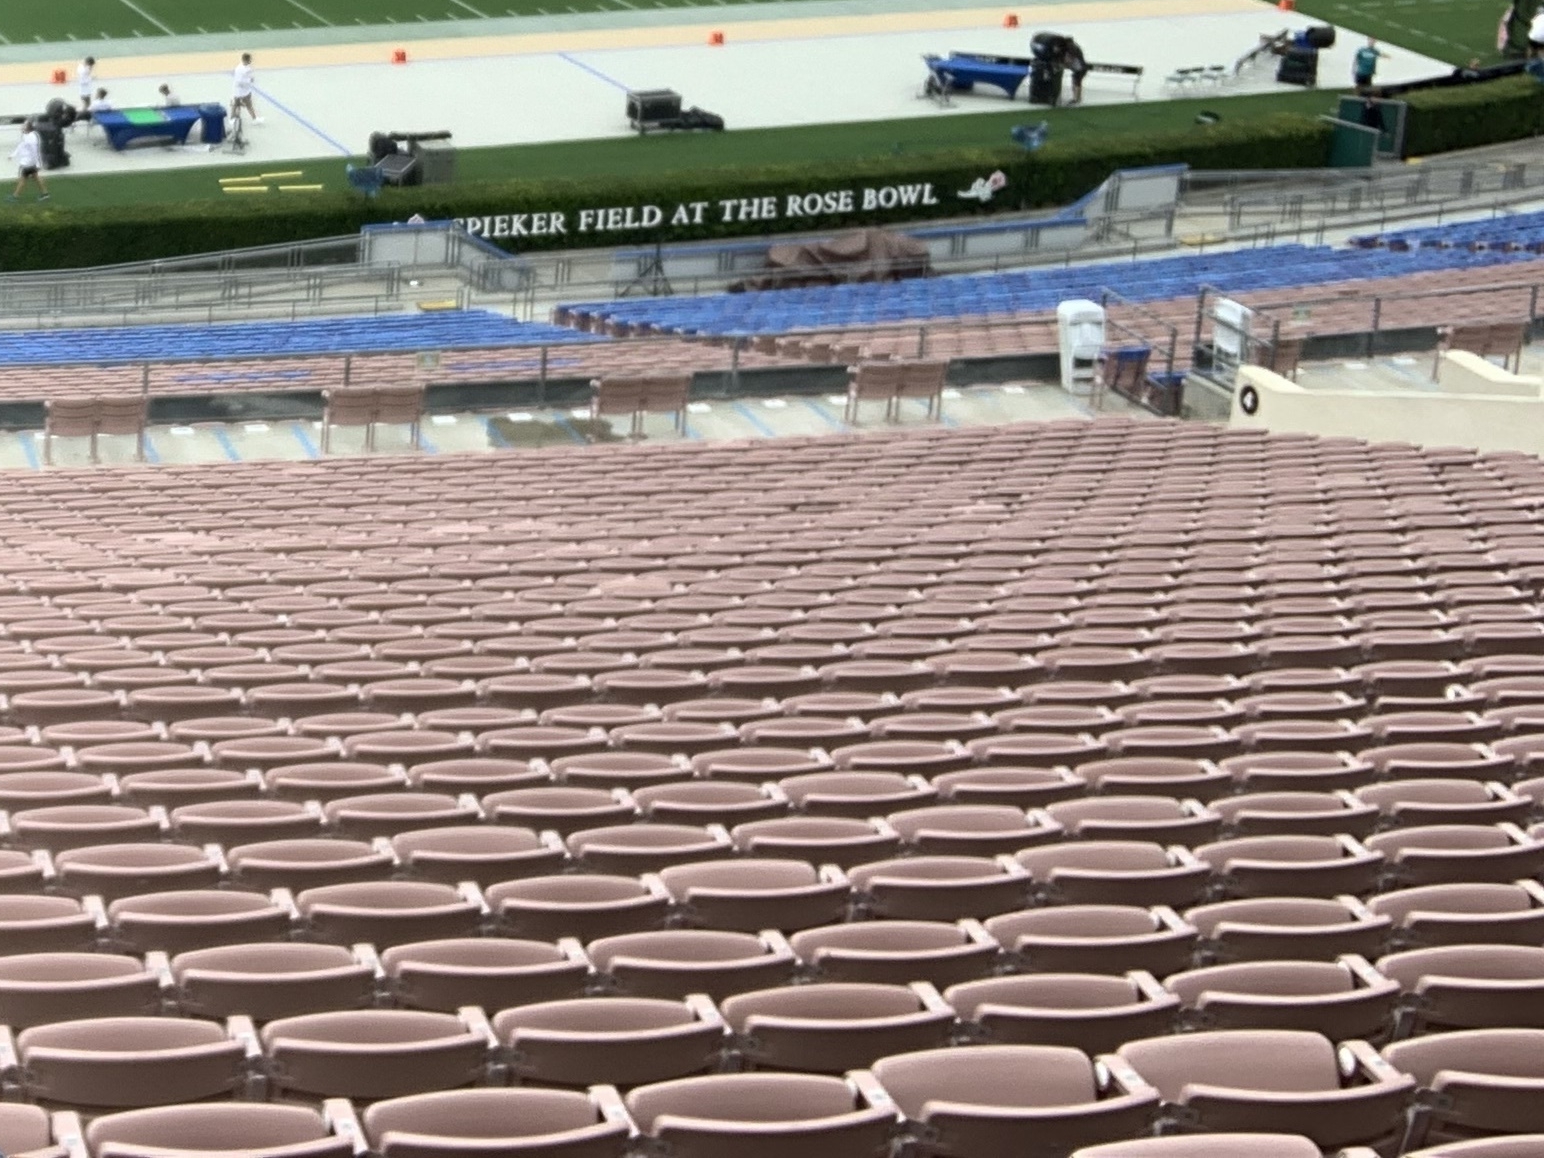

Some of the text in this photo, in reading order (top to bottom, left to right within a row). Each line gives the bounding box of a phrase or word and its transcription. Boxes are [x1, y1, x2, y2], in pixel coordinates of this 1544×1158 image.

[579, 205, 662, 230] FIELD
[671, 200, 709, 225] AT
[719, 196, 776, 221] THE
[785, 189, 853, 217] ROSE
[862, 183, 939, 211] BOWL
